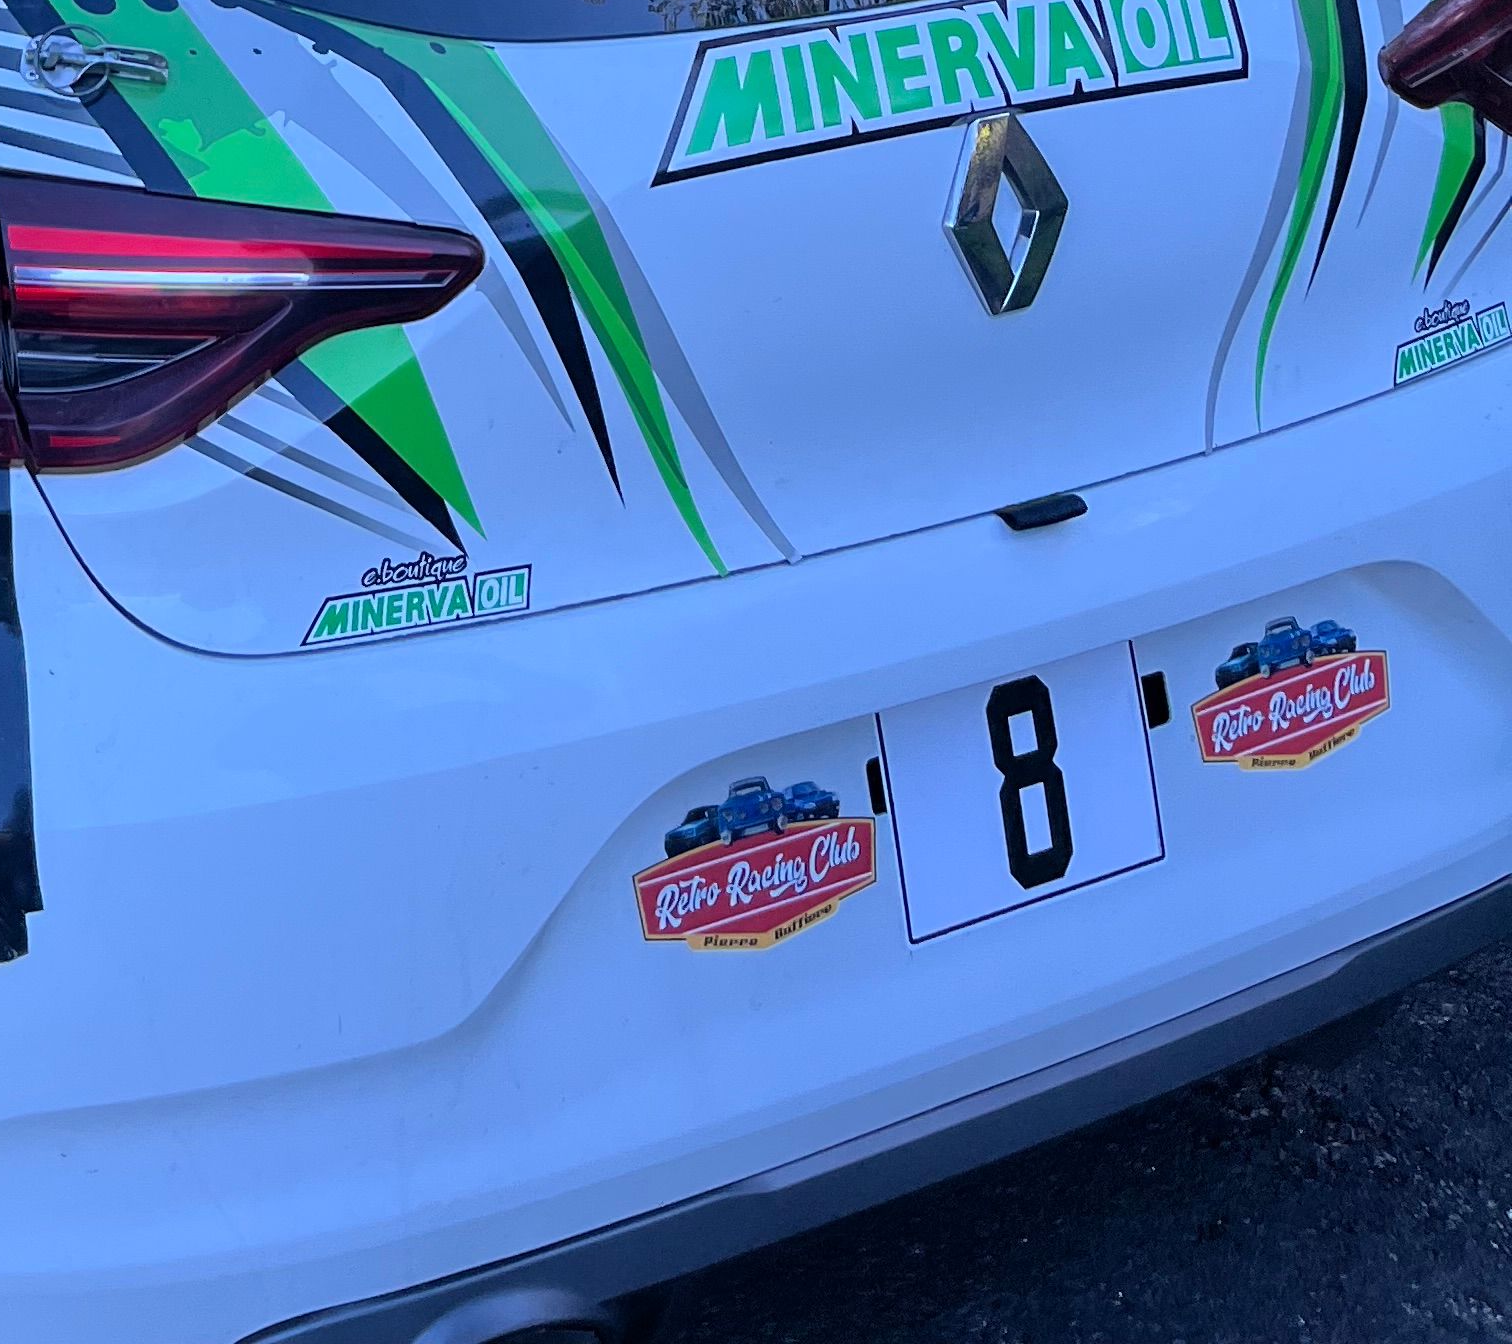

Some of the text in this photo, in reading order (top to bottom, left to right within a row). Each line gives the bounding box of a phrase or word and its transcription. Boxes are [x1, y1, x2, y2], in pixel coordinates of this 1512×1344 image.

[1398, 308, 1510, 379] MINERVA OIL
[312, 573, 525, 639] MINERVA OIL
[363, 552, 467, 587] e.boutique
[1212, 659, 1376, 753] Retro Racing Club
[986, 675, 1074, 890] 8
[655, 826, 861, 931] Retro Racing Club
